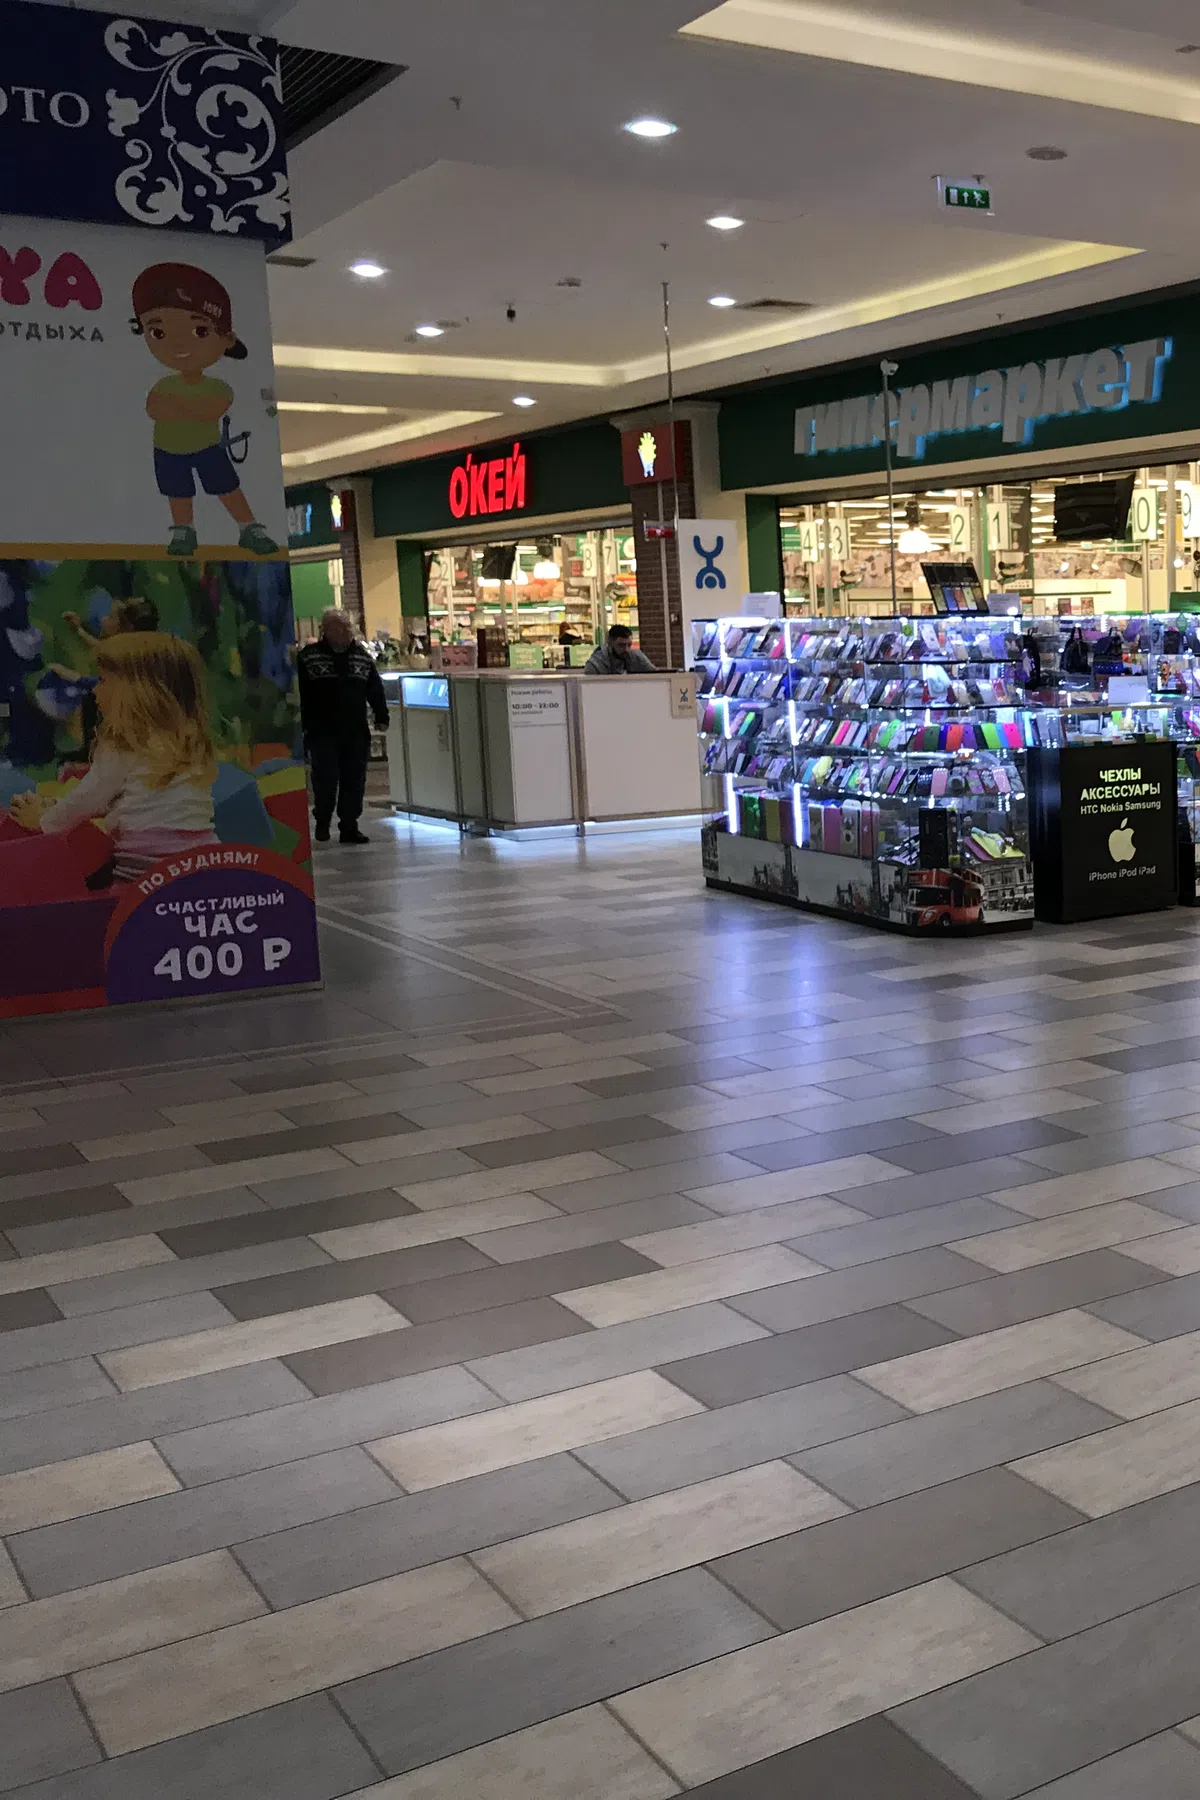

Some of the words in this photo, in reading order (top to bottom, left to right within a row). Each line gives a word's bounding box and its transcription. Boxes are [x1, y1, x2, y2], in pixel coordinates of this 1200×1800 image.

[0, 86, 90, 128] ТО
[1183, 493, 1192, 530] 9
[832, 525, 843, 555] 3
[953, 514, 965, 546] 2
[992, 511, 1001, 543] 1
[605, 546, 612, 565] 7
[803, 528, 813, 556] 4
[584, 548, 593, 571] 8
[1099, 767, 1142, 782] ЧЕХЛЫ
[1080, 782, 1161, 801] АКСЕССУАРЫ
[1080, 804, 1098, 815] HTC
[1100, 802, 1123, 813] Nokia
[1125, 800, 1161, 811] Samsung
[138, 872, 164, 895] ПО
[167, 850, 260, 876] БУДНЯМ!
[1088, 871, 1117, 881] iPhone
[1118, 867, 1137, 878] iPod
[1138, 865, 1156, 876] iPad
[155, 889, 285, 916] СЧАСТЛИВЫЙ
[184, 910, 259, 938] ЧАС
[153, 942, 243, 982] 400
